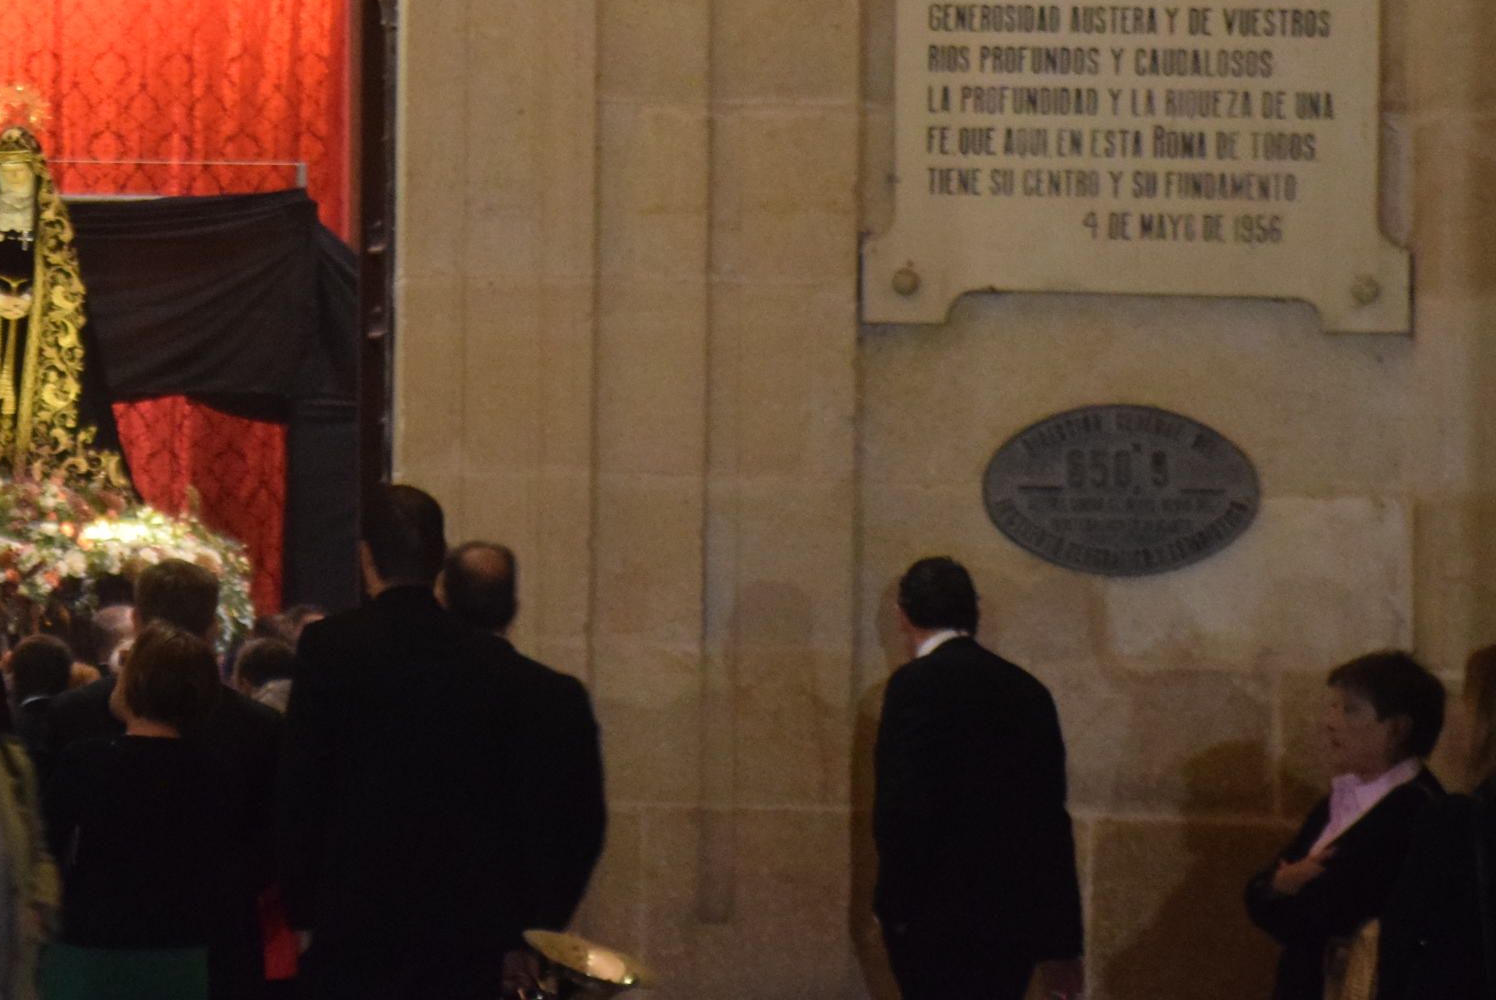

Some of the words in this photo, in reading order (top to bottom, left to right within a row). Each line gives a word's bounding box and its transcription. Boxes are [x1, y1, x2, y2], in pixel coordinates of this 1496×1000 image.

[927, 2, 1062, 33] GENEROSIDAD
[1069, 4, 1158, 34] AUSTERA
[1165, 5, 1177, 35] Y
[1187, 6, 1211, 35] DE
[1222, 6, 1332, 36] VUESTROS
[926, 44, 971, 74] RIOS
[978, 45, 1101, 76] PROFUNDOS
[1111, 47, 1123, 76] Y
[926, 84, 952, 114] LA
[959, 85, 1100, 116] PROFUNDIDAD
[1108, 87, 1121, 116] Y
[1130, 87, 1156, 116] LA
[1164, 87, 1253, 117] RIQUEZA
[1260, 89, 1286, 118] DE
[1293, 89, 1335, 118] UNA
[957, 126, 995, 157] QUE
[1055, 127, 1084, 156] EN
[1089, 127, 1144, 157] ESTA
[1214, 129, 1239, 158] DE
[927, 167, 981, 197] TIENE
[989, 168, 1016, 198] SU
[1021, 169, 1101, 199] CENTRO
[1109, 170, 1121, 199] Y
[1131, 170, 1159, 199] SU
[1106, 213, 1131, 242] DE
[1138, 213, 1197, 243] MAYO
[1201, 214, 1225, 243] DE
